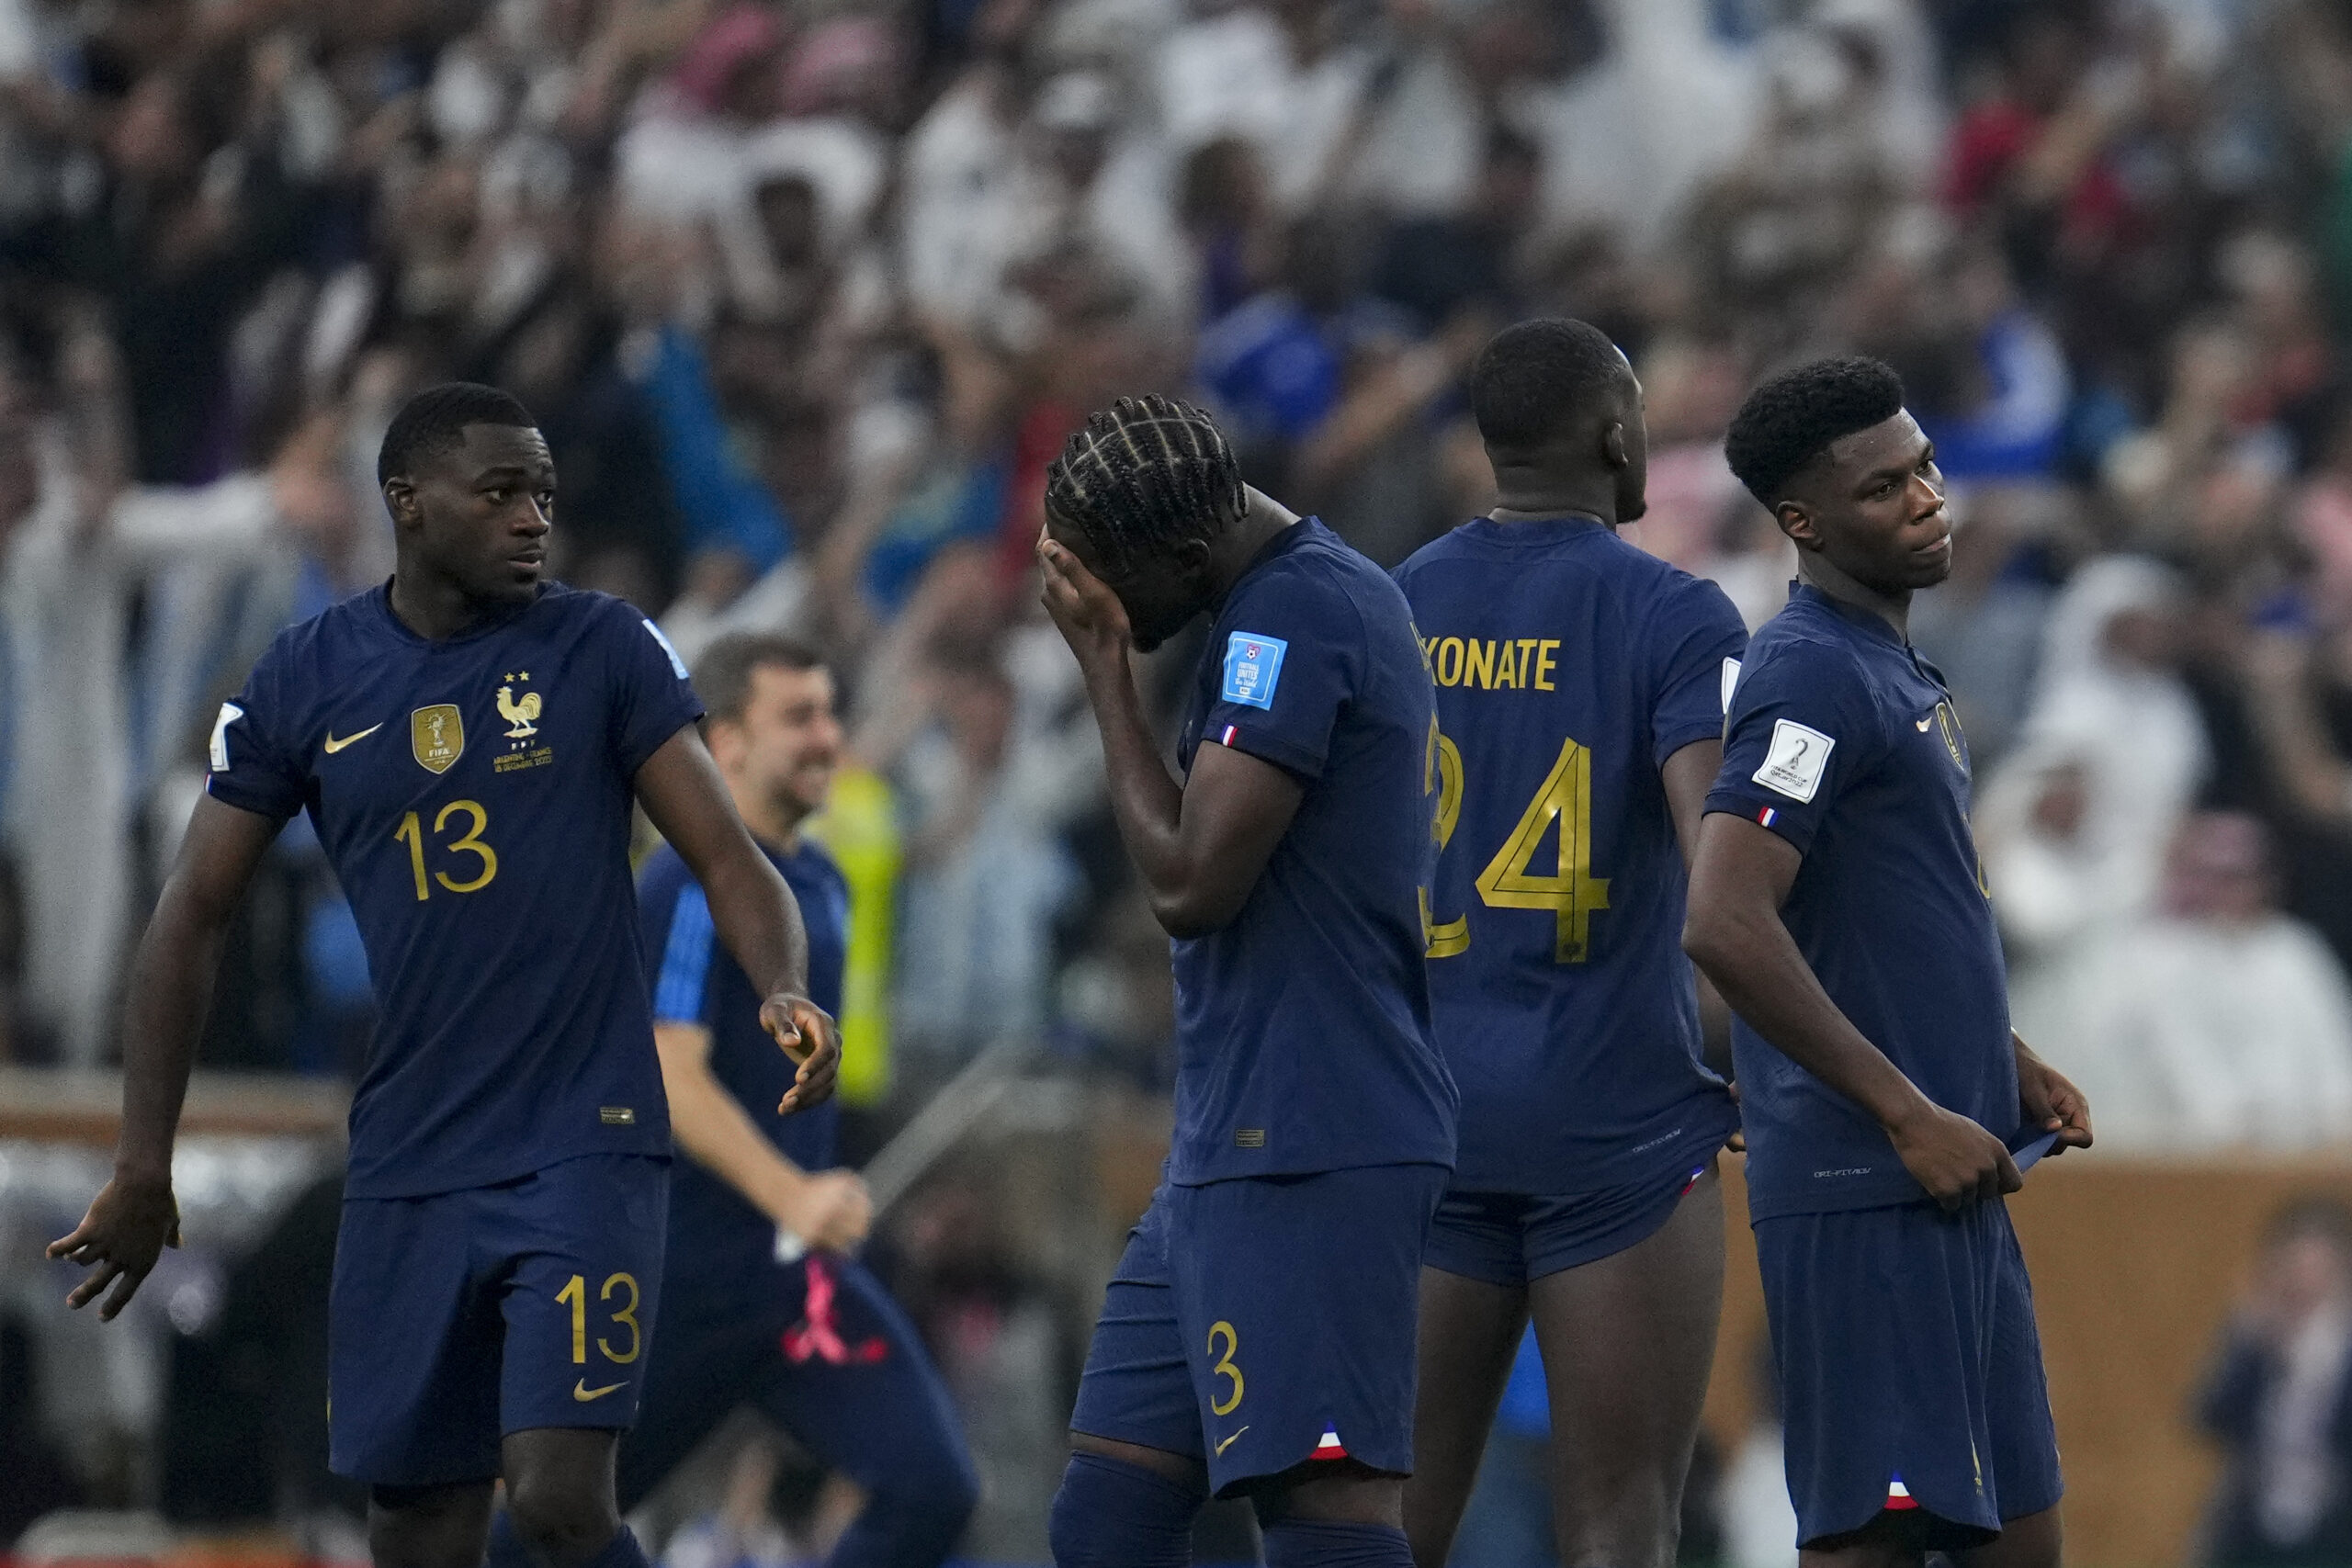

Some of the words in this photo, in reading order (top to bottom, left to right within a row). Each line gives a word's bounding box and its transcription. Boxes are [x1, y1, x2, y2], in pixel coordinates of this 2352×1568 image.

[428, 748, 449, 757] FIFA
[393, 799, 497, 901] 13
[554, 1271, 640, 1364] 13
[1207, 1320, 1245, 1416] 3
